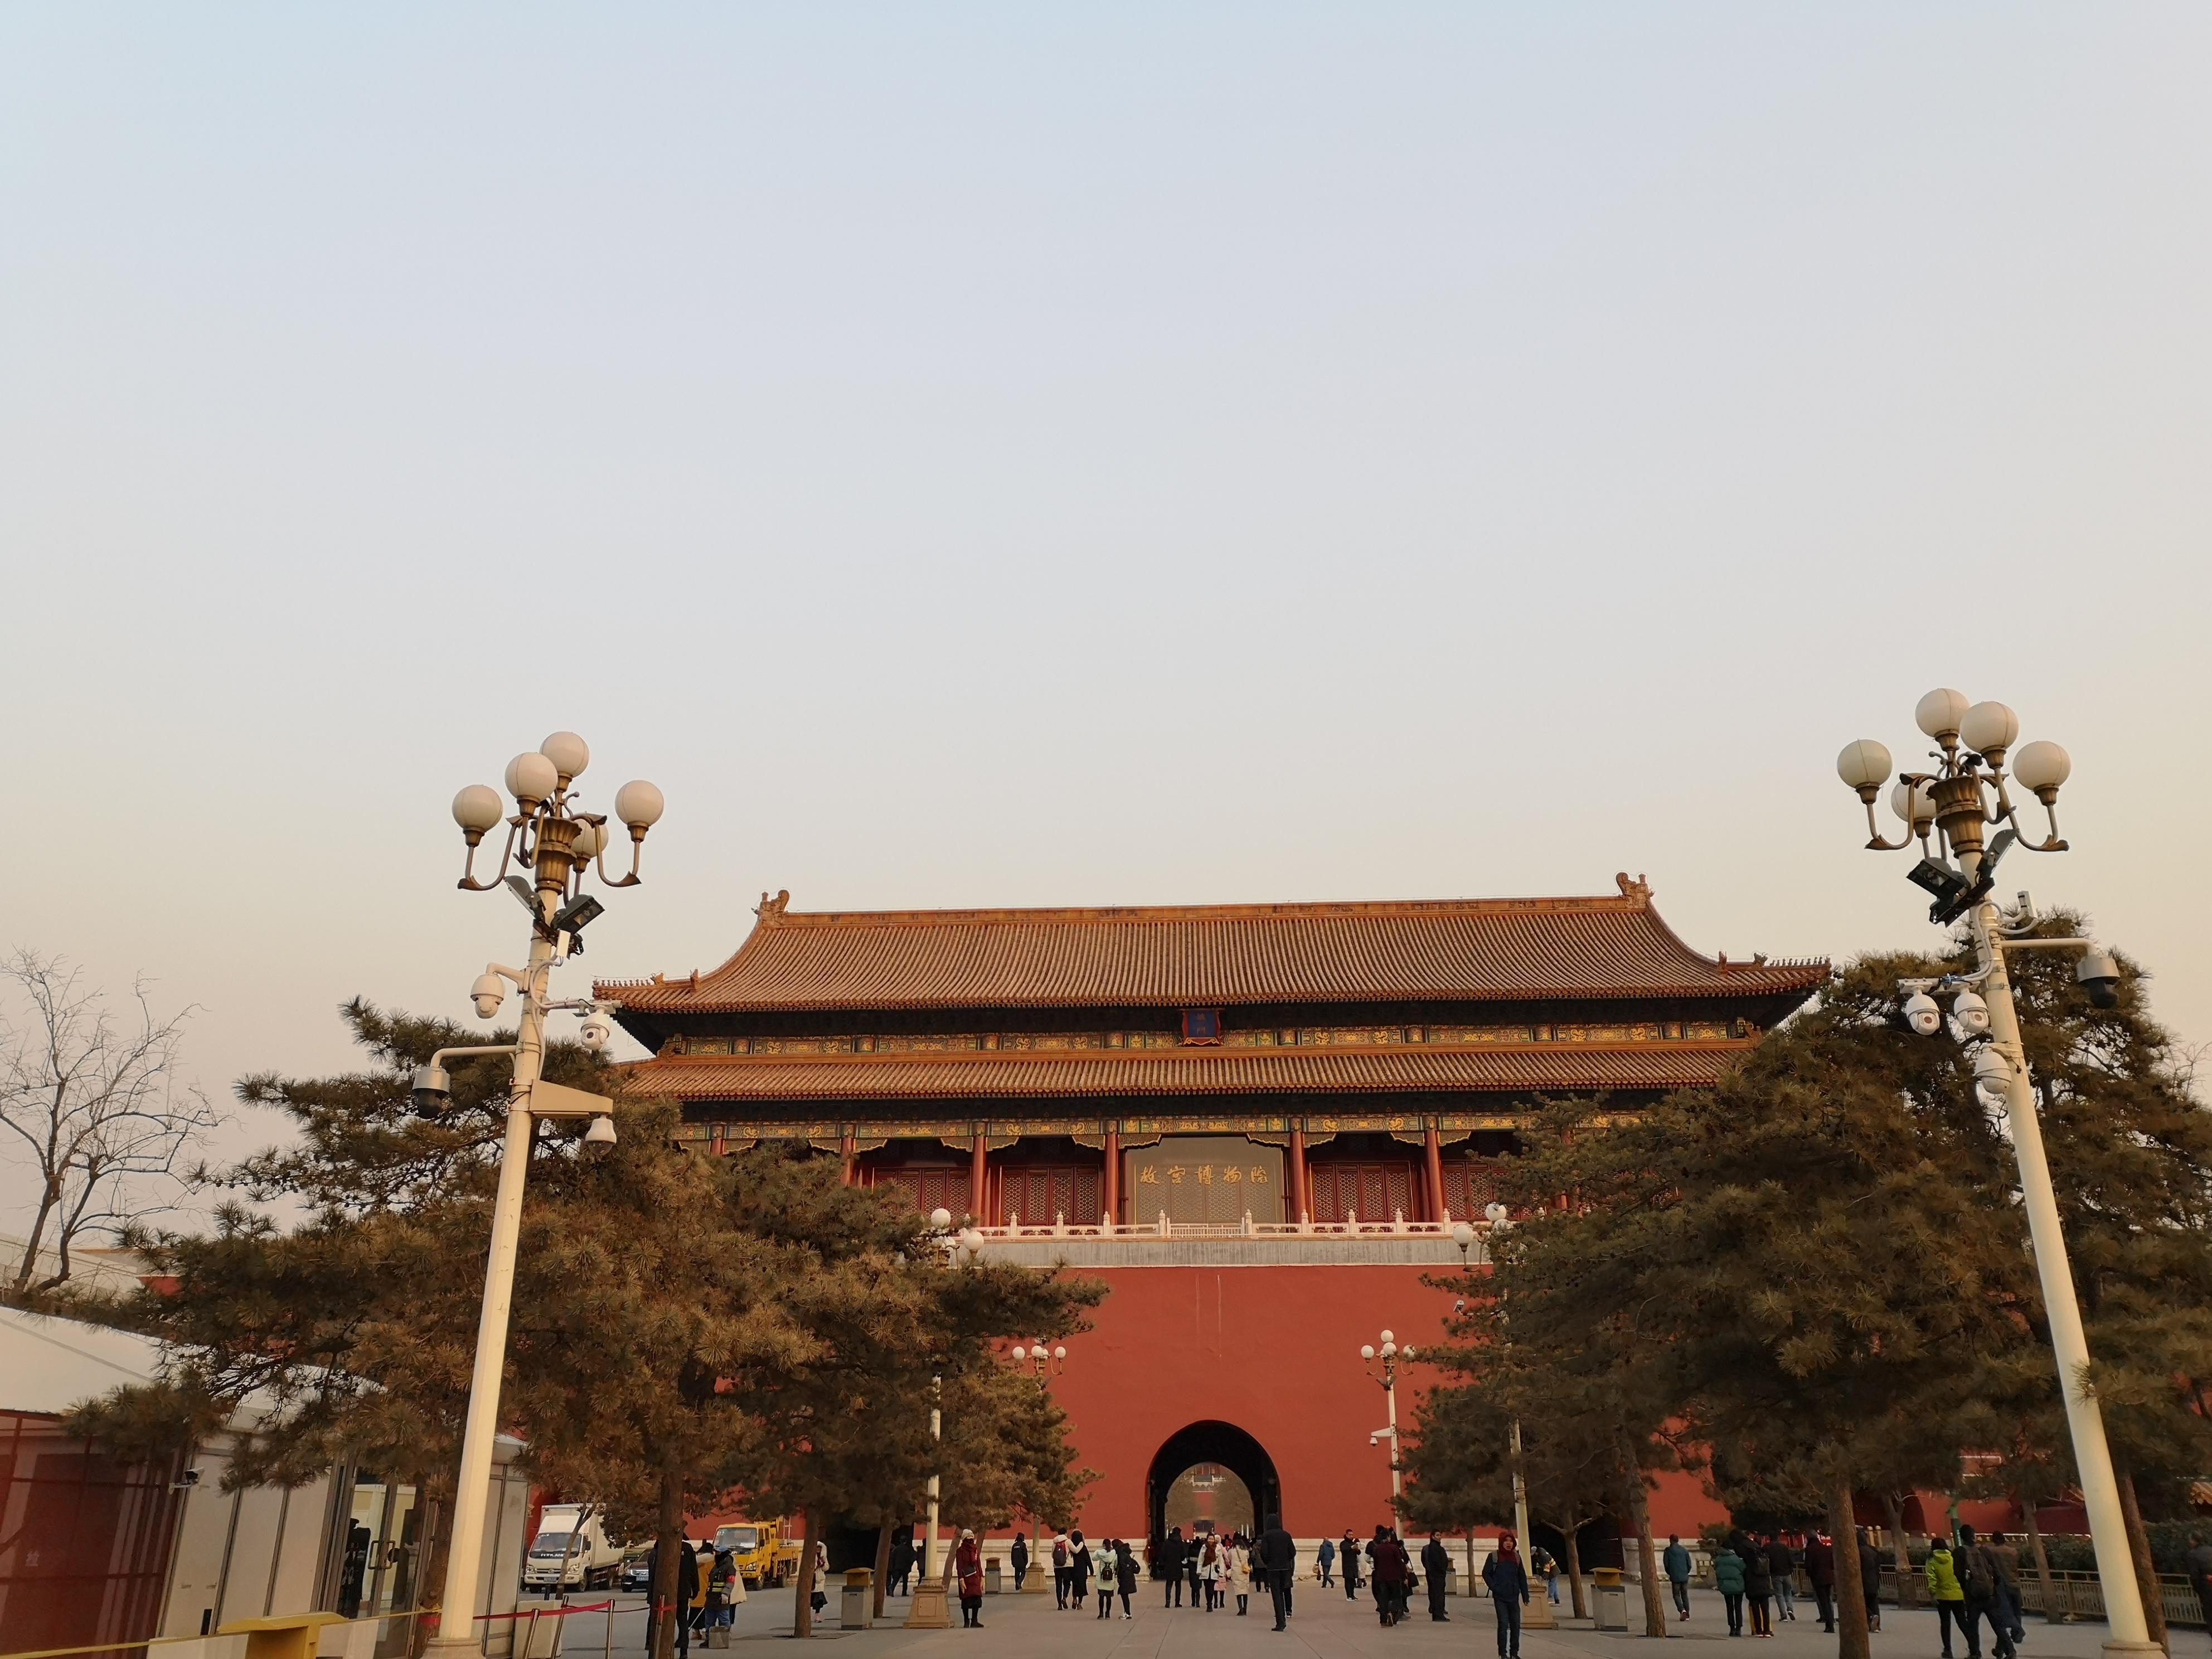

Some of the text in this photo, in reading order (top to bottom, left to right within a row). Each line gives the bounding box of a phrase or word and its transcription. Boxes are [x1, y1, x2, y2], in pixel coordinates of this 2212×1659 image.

[1140, 1165, 1268, 1185] 故宫博物院
